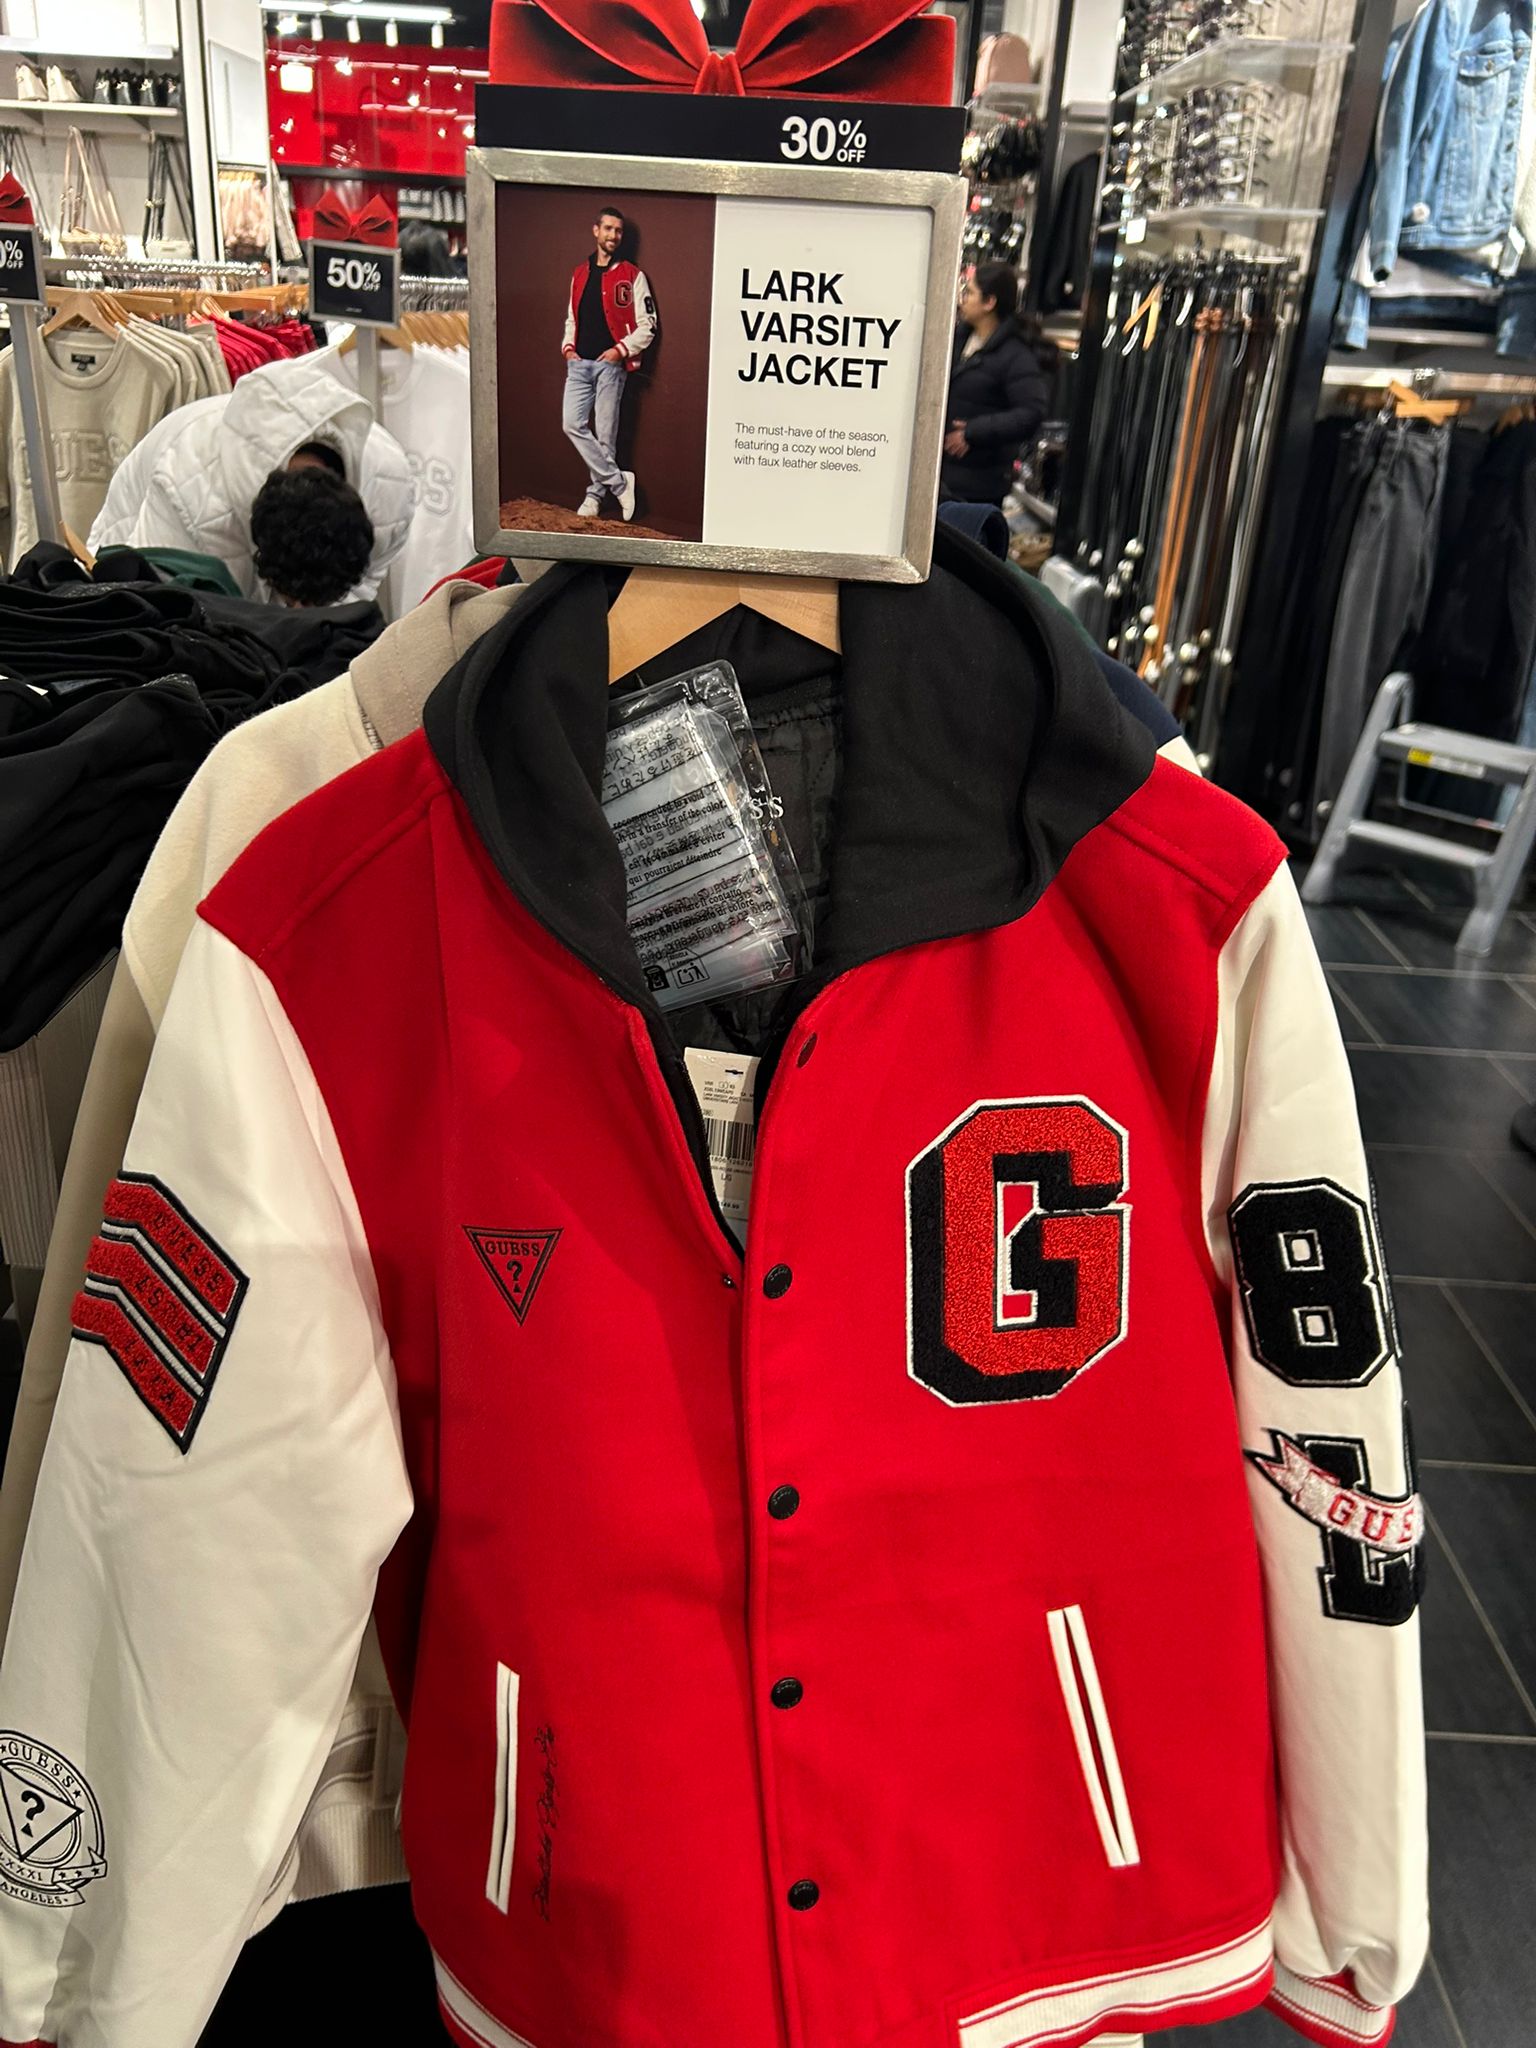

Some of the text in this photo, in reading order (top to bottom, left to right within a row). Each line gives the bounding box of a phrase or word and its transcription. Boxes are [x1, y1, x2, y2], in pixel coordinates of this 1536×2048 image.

[781, 115, 867, 160] 30%
[836, 148, 866, 163] OFF
[7, 260, 24, 269] OFF
[326, 257, 381, 290] 50%
[362, 283, 380, 292] OFF
[741, 268, 844, 304] LARK
[740, 310, 902, 349] VARSITY
[738, 352, 888, 389] JACKET
[735, 422, 889, 443] The must-have of the season,
[735, 439, 876, 457] featuring a cozy wool blend
[734, 455, 861, 472] with faux leather sleeves.
[648, 814, 678, 833] transfer
[628, 873, 642, 886] qui
[644, 859, 684, 882] pourraient
[152, 1211, 226, 1293] GUESS
[485, 1241, 541, 1257] GUESS
[905, 1094, 1132, 1408] G
[1227, 1178, 1399, 1388] 8
[8, 1741, 74, 1788] GUESS
